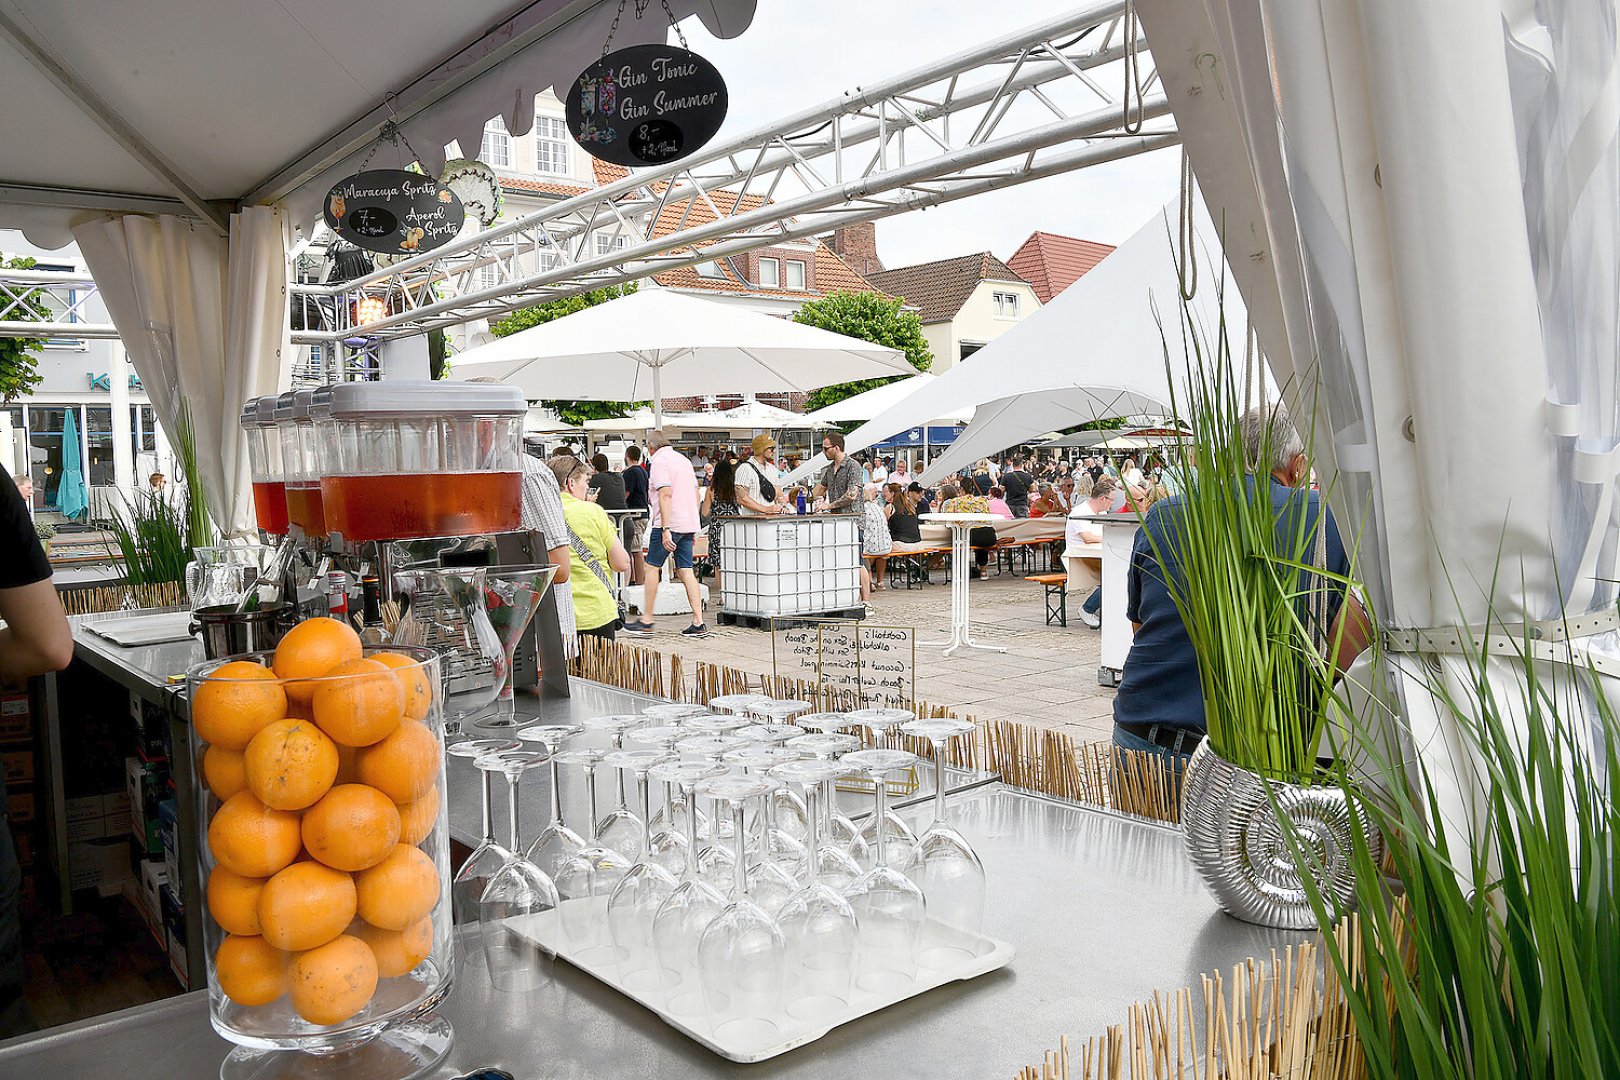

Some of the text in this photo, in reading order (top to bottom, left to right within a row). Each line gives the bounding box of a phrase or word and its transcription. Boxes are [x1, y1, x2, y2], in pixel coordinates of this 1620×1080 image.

[618, 57, 698, 89] Gin Tonic
[619, 90, 718, 121] Gin Summer
[401, 180, 437, 200] Spritz
[405, 205, 446, 226] Aperol
[424, 220, 459, 241] Spritz
